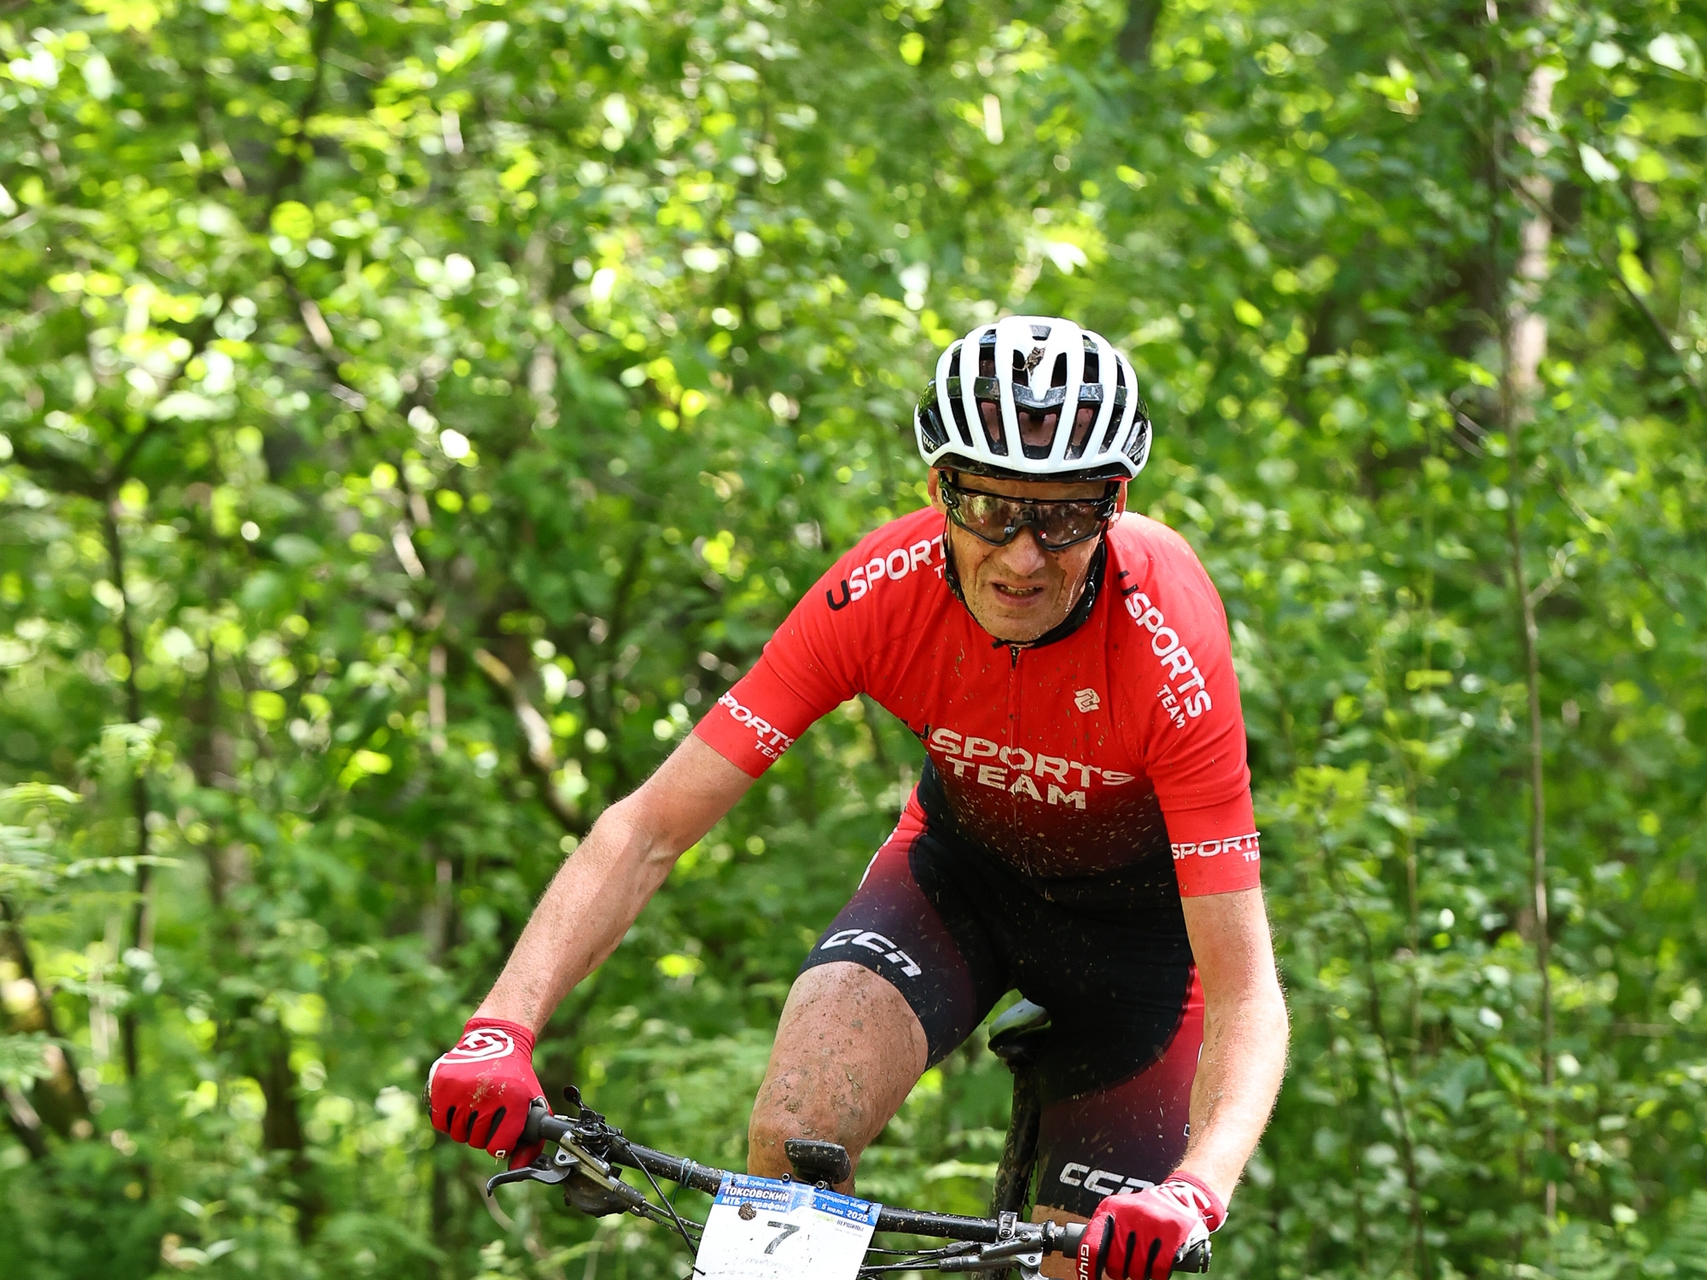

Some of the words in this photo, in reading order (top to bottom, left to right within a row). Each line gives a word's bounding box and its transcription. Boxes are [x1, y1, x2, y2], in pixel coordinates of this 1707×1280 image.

[826, 532, 948, 611] USPORT
[1156, 684, 1187, 729] TEAM
[754, 740, 782, 761] TEA
[945, 755, 1087, 810] TEAM
[721, 1196, 741, 1206] МТБ
[846, 1209, 869, 1223] 2025
[763, 1220, 801, 1255] 7
